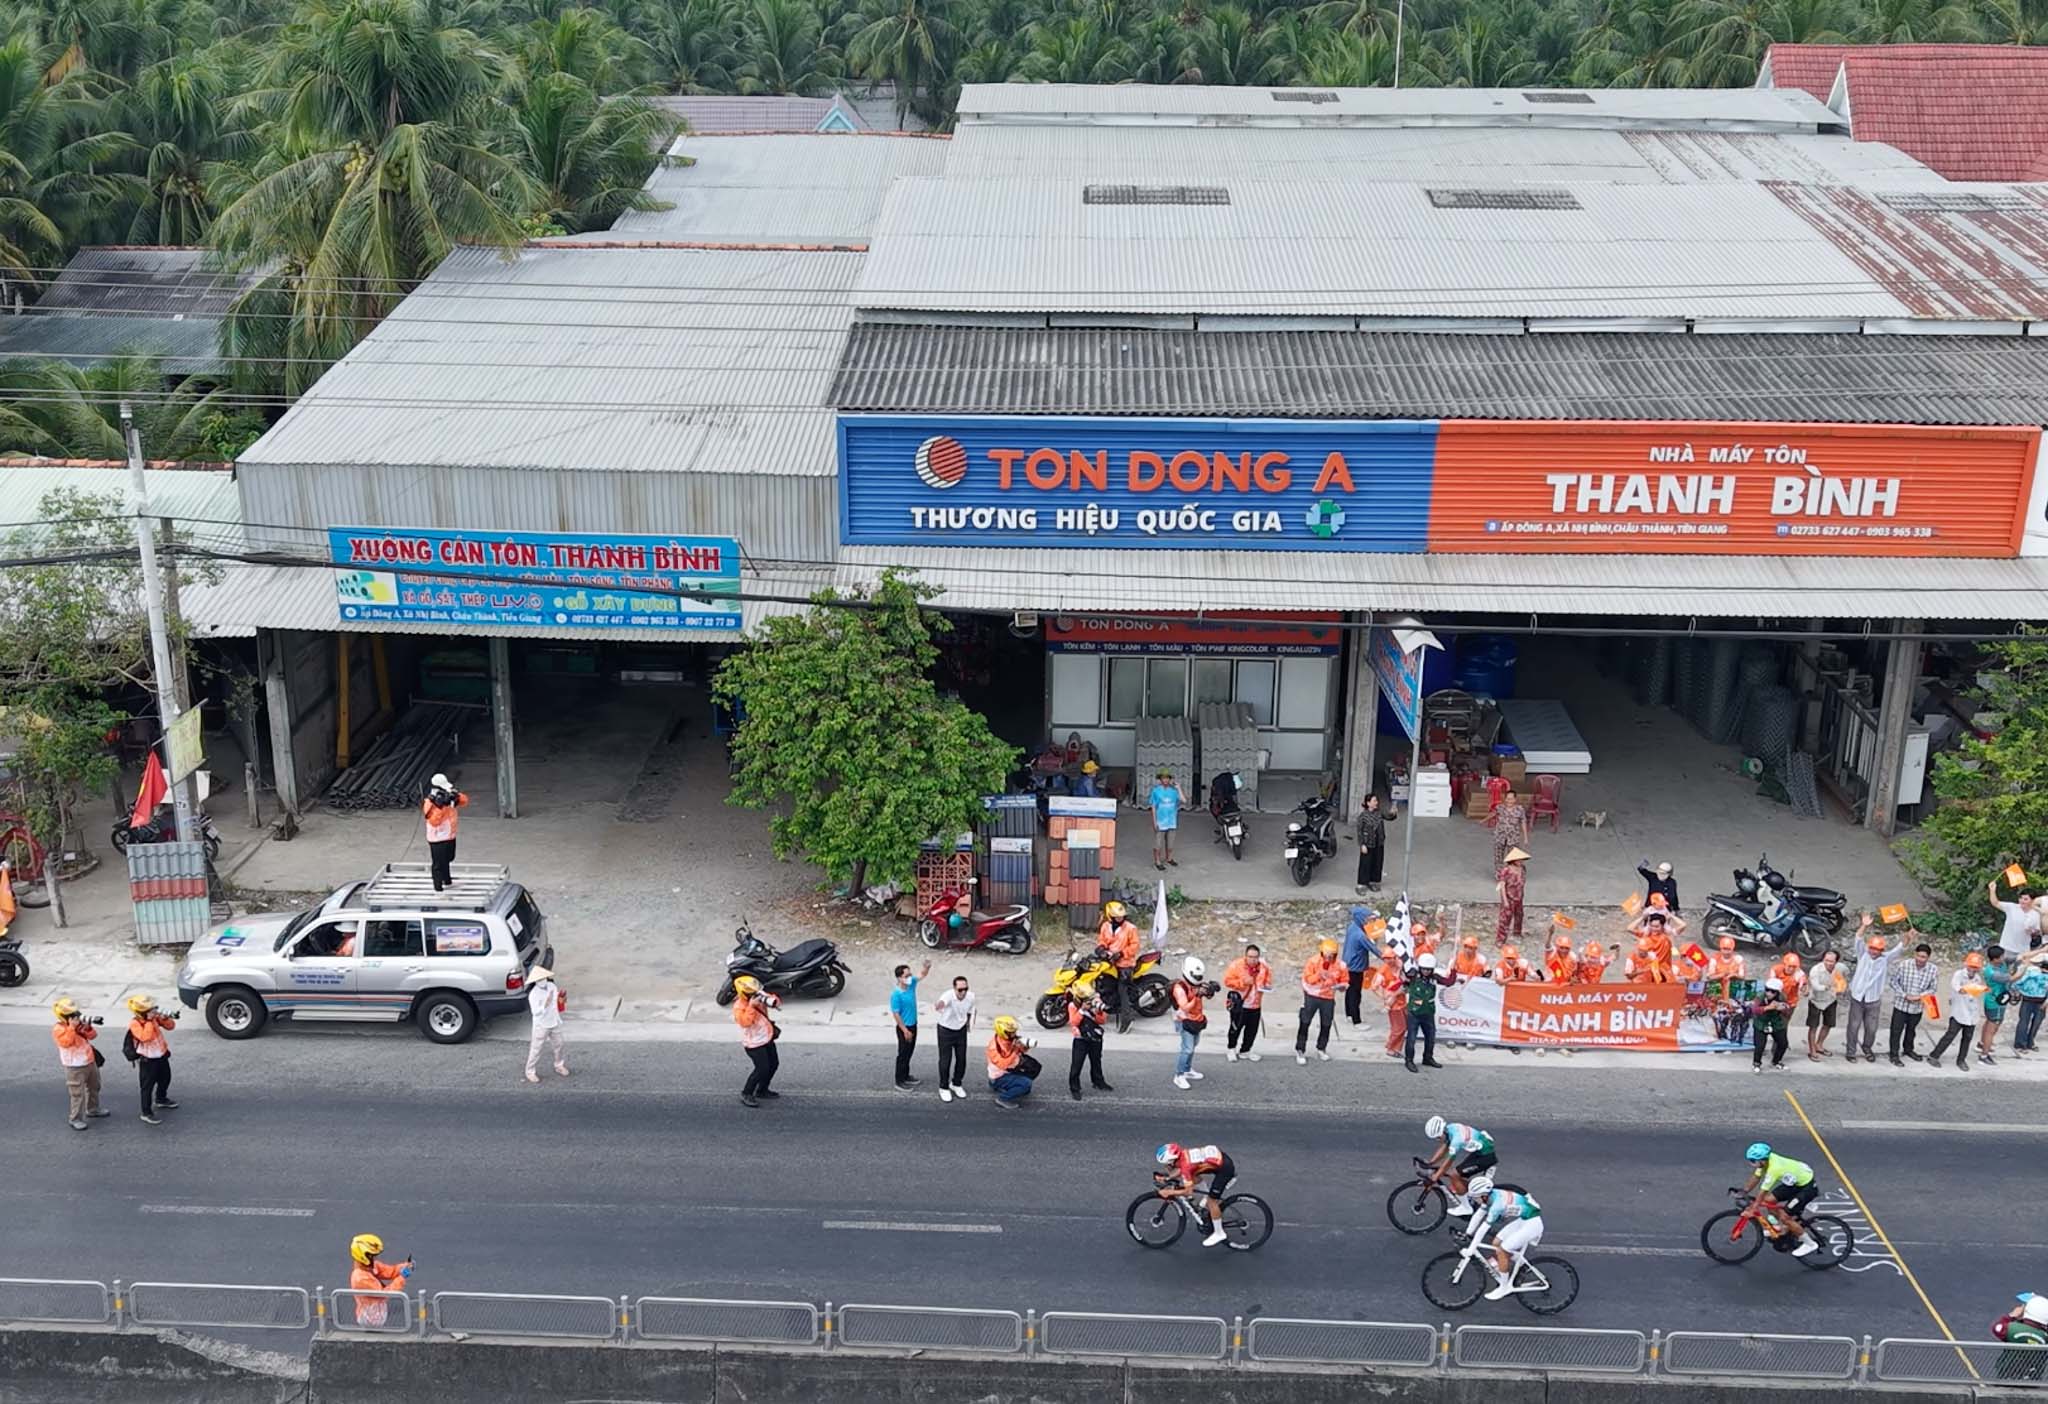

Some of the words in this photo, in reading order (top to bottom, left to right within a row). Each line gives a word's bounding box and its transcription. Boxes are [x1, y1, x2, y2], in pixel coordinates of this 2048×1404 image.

[1649, 443, 1695, 462] NHÀ
[1709, 443, 1754, 463] MÁY
[1764, 444, 1807, 464] TÔN
[987, 448, 1108, 491] TON
[1128, 450, 1292, 493] DONG
[1312, 451, 1356, 493] A
[1546, 474, 1736, 514] THANH
[1770, 464, 1900, 516] BÌNH
[910, 506, 1037, 530] THƯƠNG
[1056, 502, 1119, 535] HIỆU
[1137, 502, 1216, 536] QUỐC
[1232, 510, 1282, 532] GIA
[1791, 526, 1819, 536] 02733
[1822, 526, 1839, 536] 627
[1841, 527, 1860, 537] 447
[1867, 527, 1890, 537] 0903
[1892, 527, 1911, 538] 965
[1913, 528, 1932, 538] 338
[548, 542, 648, 571] THANH
[653, 540, 723, 573] BÌNH
[592, 593, 625, 612] XÂY
[630, 596, 677, 614] DỰNG
[1080, 619, 1109, 630] TON
[1114, 620, 1153, 631] DONG
[1158, 621, 1169, 631] A
[1540, 993, 1573, 1005] NHÀ
[1578, 992, 1612, 1004] MÁY
[1616, 992, 1648, 1002] TÔN
[1439, 1016, 1478, 1028] DONG
[1481, 1019, 1490, 1028] A
[1507, 1011, 1601, 1032] THANH
[1610, 1006, 1674, 1032] BÌNH
